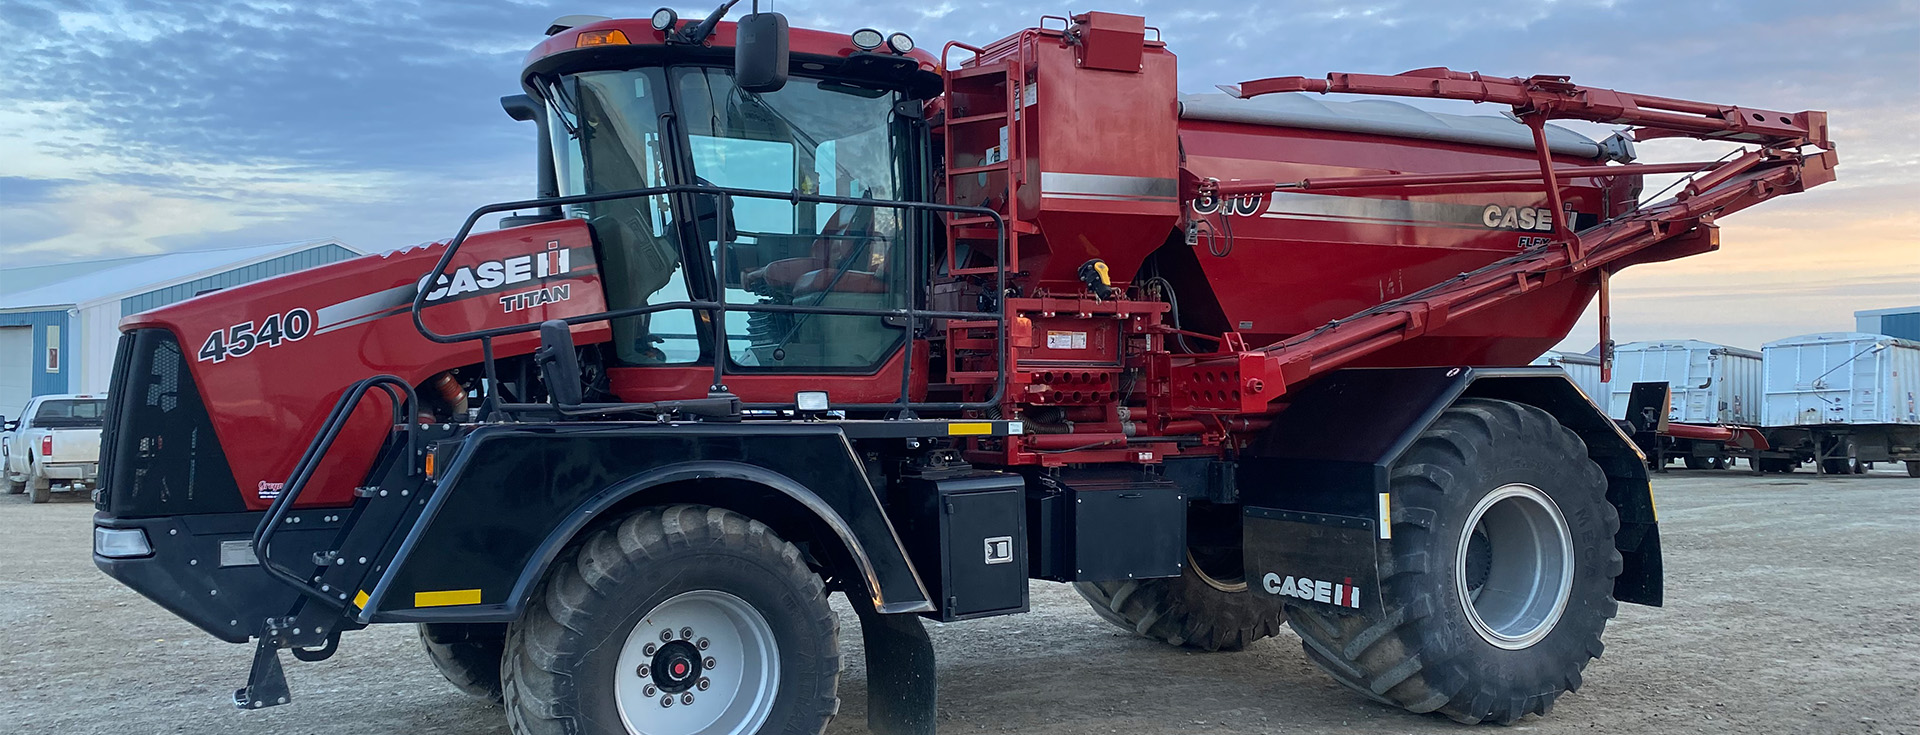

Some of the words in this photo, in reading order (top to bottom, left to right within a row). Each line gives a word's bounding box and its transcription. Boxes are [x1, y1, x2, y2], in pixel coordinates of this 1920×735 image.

[1482, 205, 1552, 231] CASE
[417, 255, 531, 301] CASE
[500, 284, 570, 314] TITAN
[198, 307, 312, 364] 4540
[1262, 572, 1332, 604] CASE
